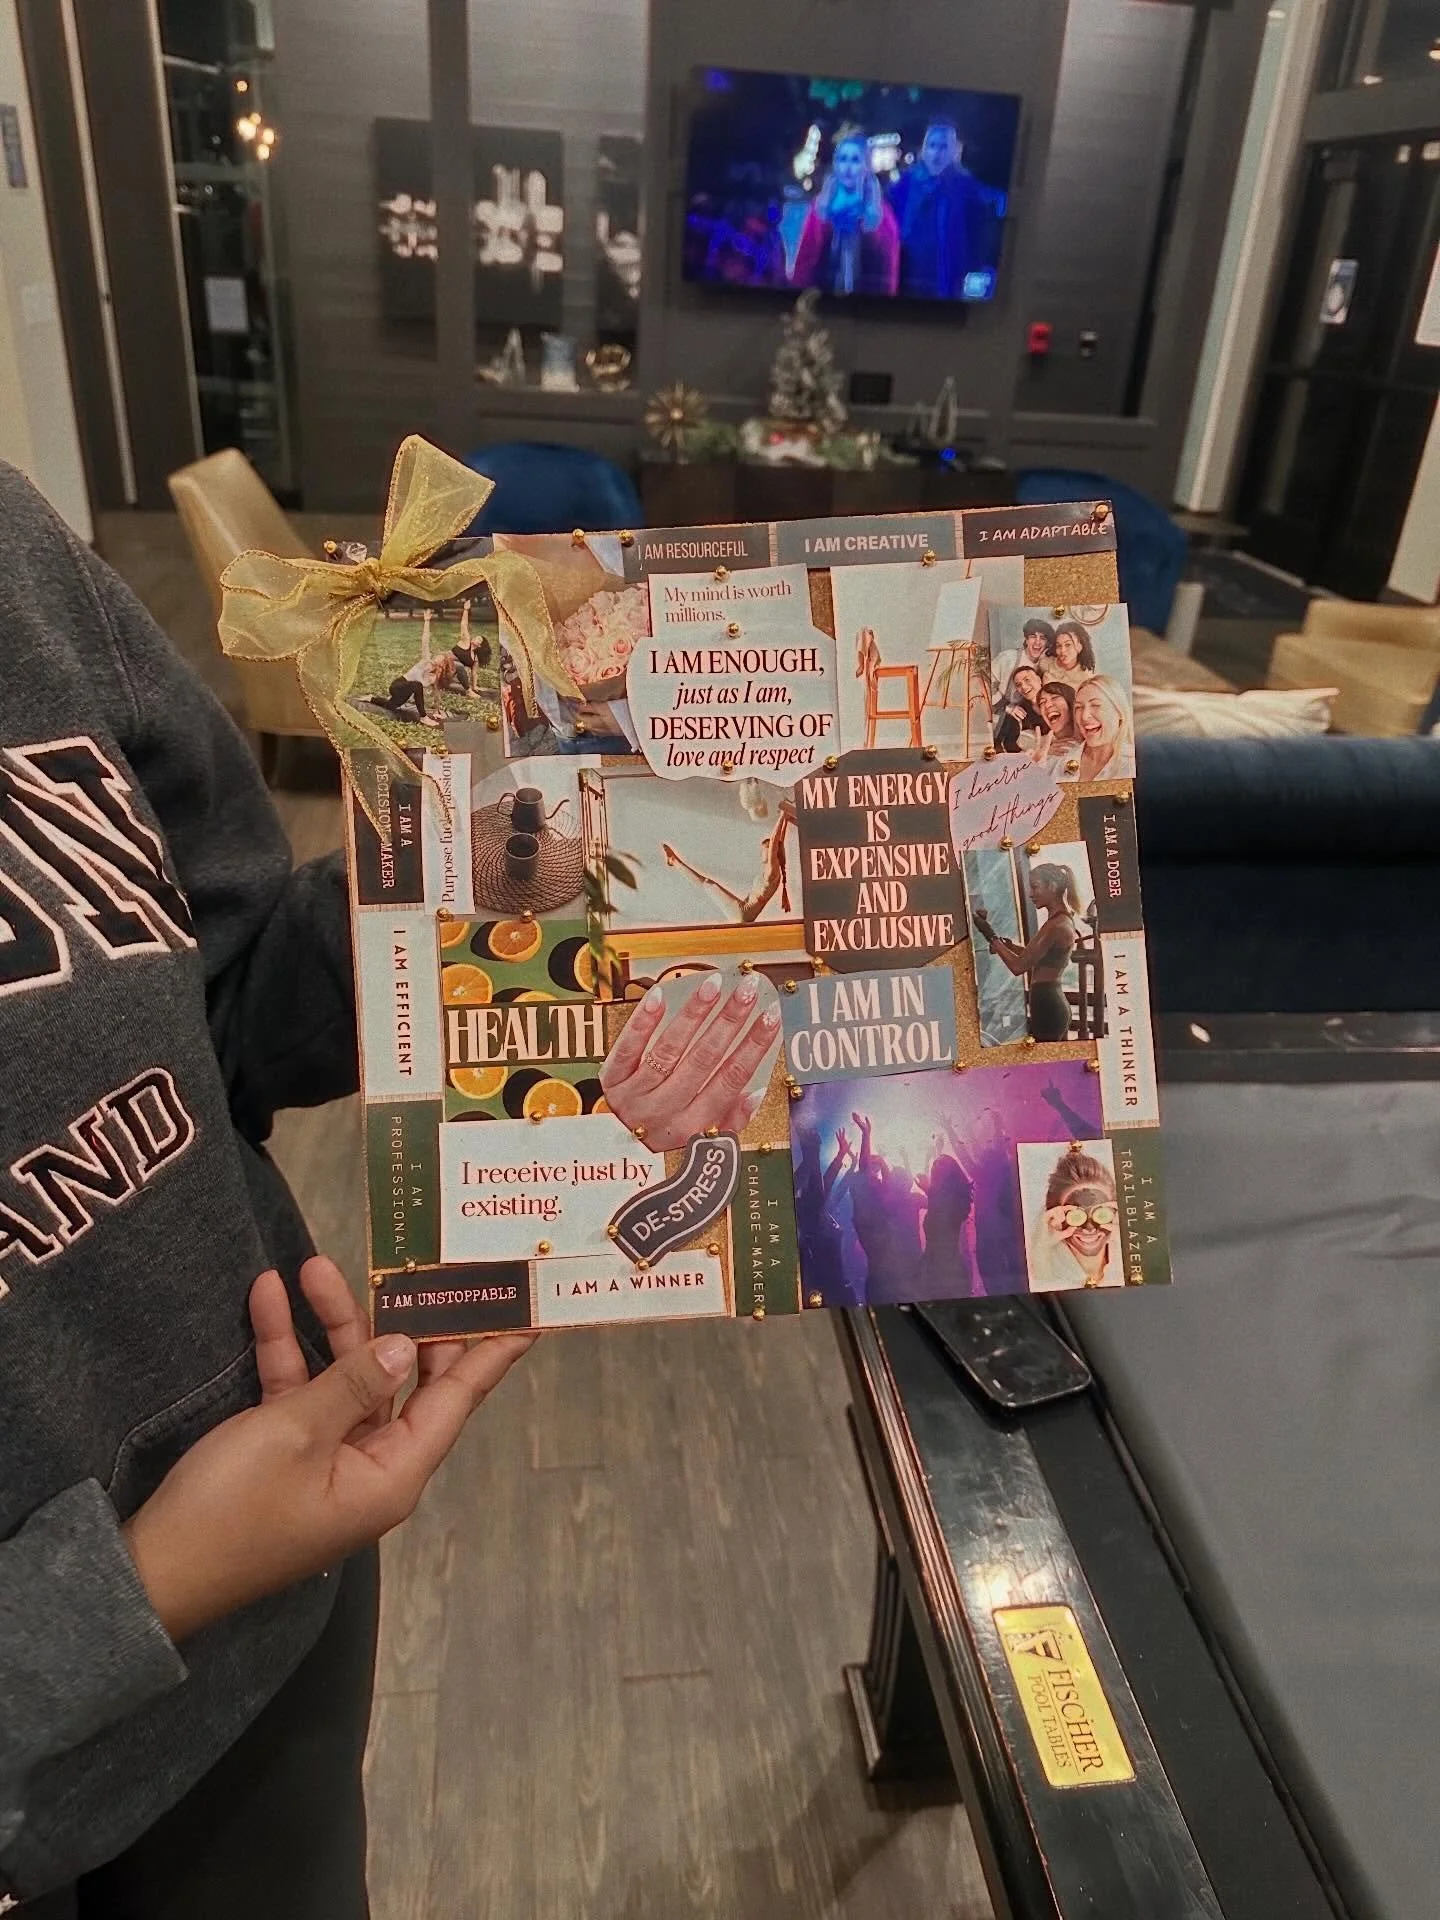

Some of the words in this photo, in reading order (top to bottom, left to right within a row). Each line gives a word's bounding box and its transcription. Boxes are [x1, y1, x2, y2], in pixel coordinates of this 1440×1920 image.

[805, 538, 810, 552] I
[813, 536, 840, 552] AM
[844, 533, 929, 550] CREATIVE
[979, 530, 988, 542] I
[992, 528, 1016, 541] AM
[1020, 521, 1109, 540] ADAPTABLE
[645, 543, 664, 560] AM
[666, 540, 748, 559] RESOURCEFUL
[664, 586, 687, 606] My
[691, 586, 730, 602] mind
[732, 586, 745, 600] is
[747, 580, 792, 598] worth
[665, 607, 726, 623] millions.
[650, 650, 659, 674] I
[664, 650, 703, 674] AM
[708, 648, 825, 676] ENOUGH,
[673, 682, 713, 710] just
[717, 687, 739, 704] as
[743, 681, 753, 704] I
[756, 684, 792, 706] am,
[650, 715, 794, 740] DESERVING
[800, 713, 833, 738] OF
[666, 743, 704, 766] love
[708, 742, 744, 767] and
[749, 745, 815, 770] respect
[802, 776, 838, 810] MY
[847, 771, 949, 808] ENERGY
[952, 789, 961, 811] I
[968, 761, 1032, 800] deserve
[399, 803, 411, 812] I
[1103, 814, 1116, 823] I
[399, 815, 413, 834] AM
[866, 809, 891, 843] IS
[962, 806, 999, 850] good
[997, 793, 1059, 836] things
[400, 839, 413, 848] A
[1103, 827, 1117, 845] AM
[810, 842, 950, 881] EXPENSIVE
[1106, 849, 1117, 857] A
[441, 847, 458, 902] Purpose
[1106, 861, 1122, 898] DOER
[856, 881, 908, 915] AND
[813, 914, 955, 953] EXCLUSIVE
[394, 944, 408, 971] AM
[1115, 969, 1129, 995] AM
[808, 983, 821, 1025] I
[832, 978, 882, 1023] AM
[890, 975, 925, 1018] IN
[1118, 1006, 1131, 1016] A
[396, 981, 412, 1076] EFFICIENT
[447, 1004, 605, 1064] HEALTH
[790, 1020, 952, 1073] CONTROL
[1120, 1025, 1138, 1106] THINKER
[411, 1163, 422, 1171] I
[461, 1161, 471, 1185] I
[477, 1160, 567, 1185] receive
[572, 1159, 615, 1186] just
[622, 1157, 653, 1187] by
[391, 1116, 407, 1254] PROFESSIONAL
[411, 1186, 424, 1207] AM
[631, 1147, 726, 1241] DE-STRESS
[461, 1194, 563, 1221] existing.
[767, 1199, 778, 1207] I
[1120, 1149, 1142, 1274] TRAILBLAZER
[1143, 1200, 1157, 1220] AM
[747, 1164, 765, 1303] CHANGE-MAKER
[768, 1223, 780, 1243] AM
[1146, 1235, 1158, 1244] A
[770, 1258, 781, 1267] A
[381, 1295, 390, 1309] I
[394, 1294, 413, 1307] AM
[418, 1286, 517, 1306] UNSTOPPABLE
[572, 1281, 598, 1296] AM
[609, 1279, 620, 1292] A
[629, 1272, 705, 1290] WINNER
[1028, 1675, 1051, 1713] POOL
[1042, 1717, 1072, 1769] TABLES
[1048, 1669, 1104, 1772] FISCHER
